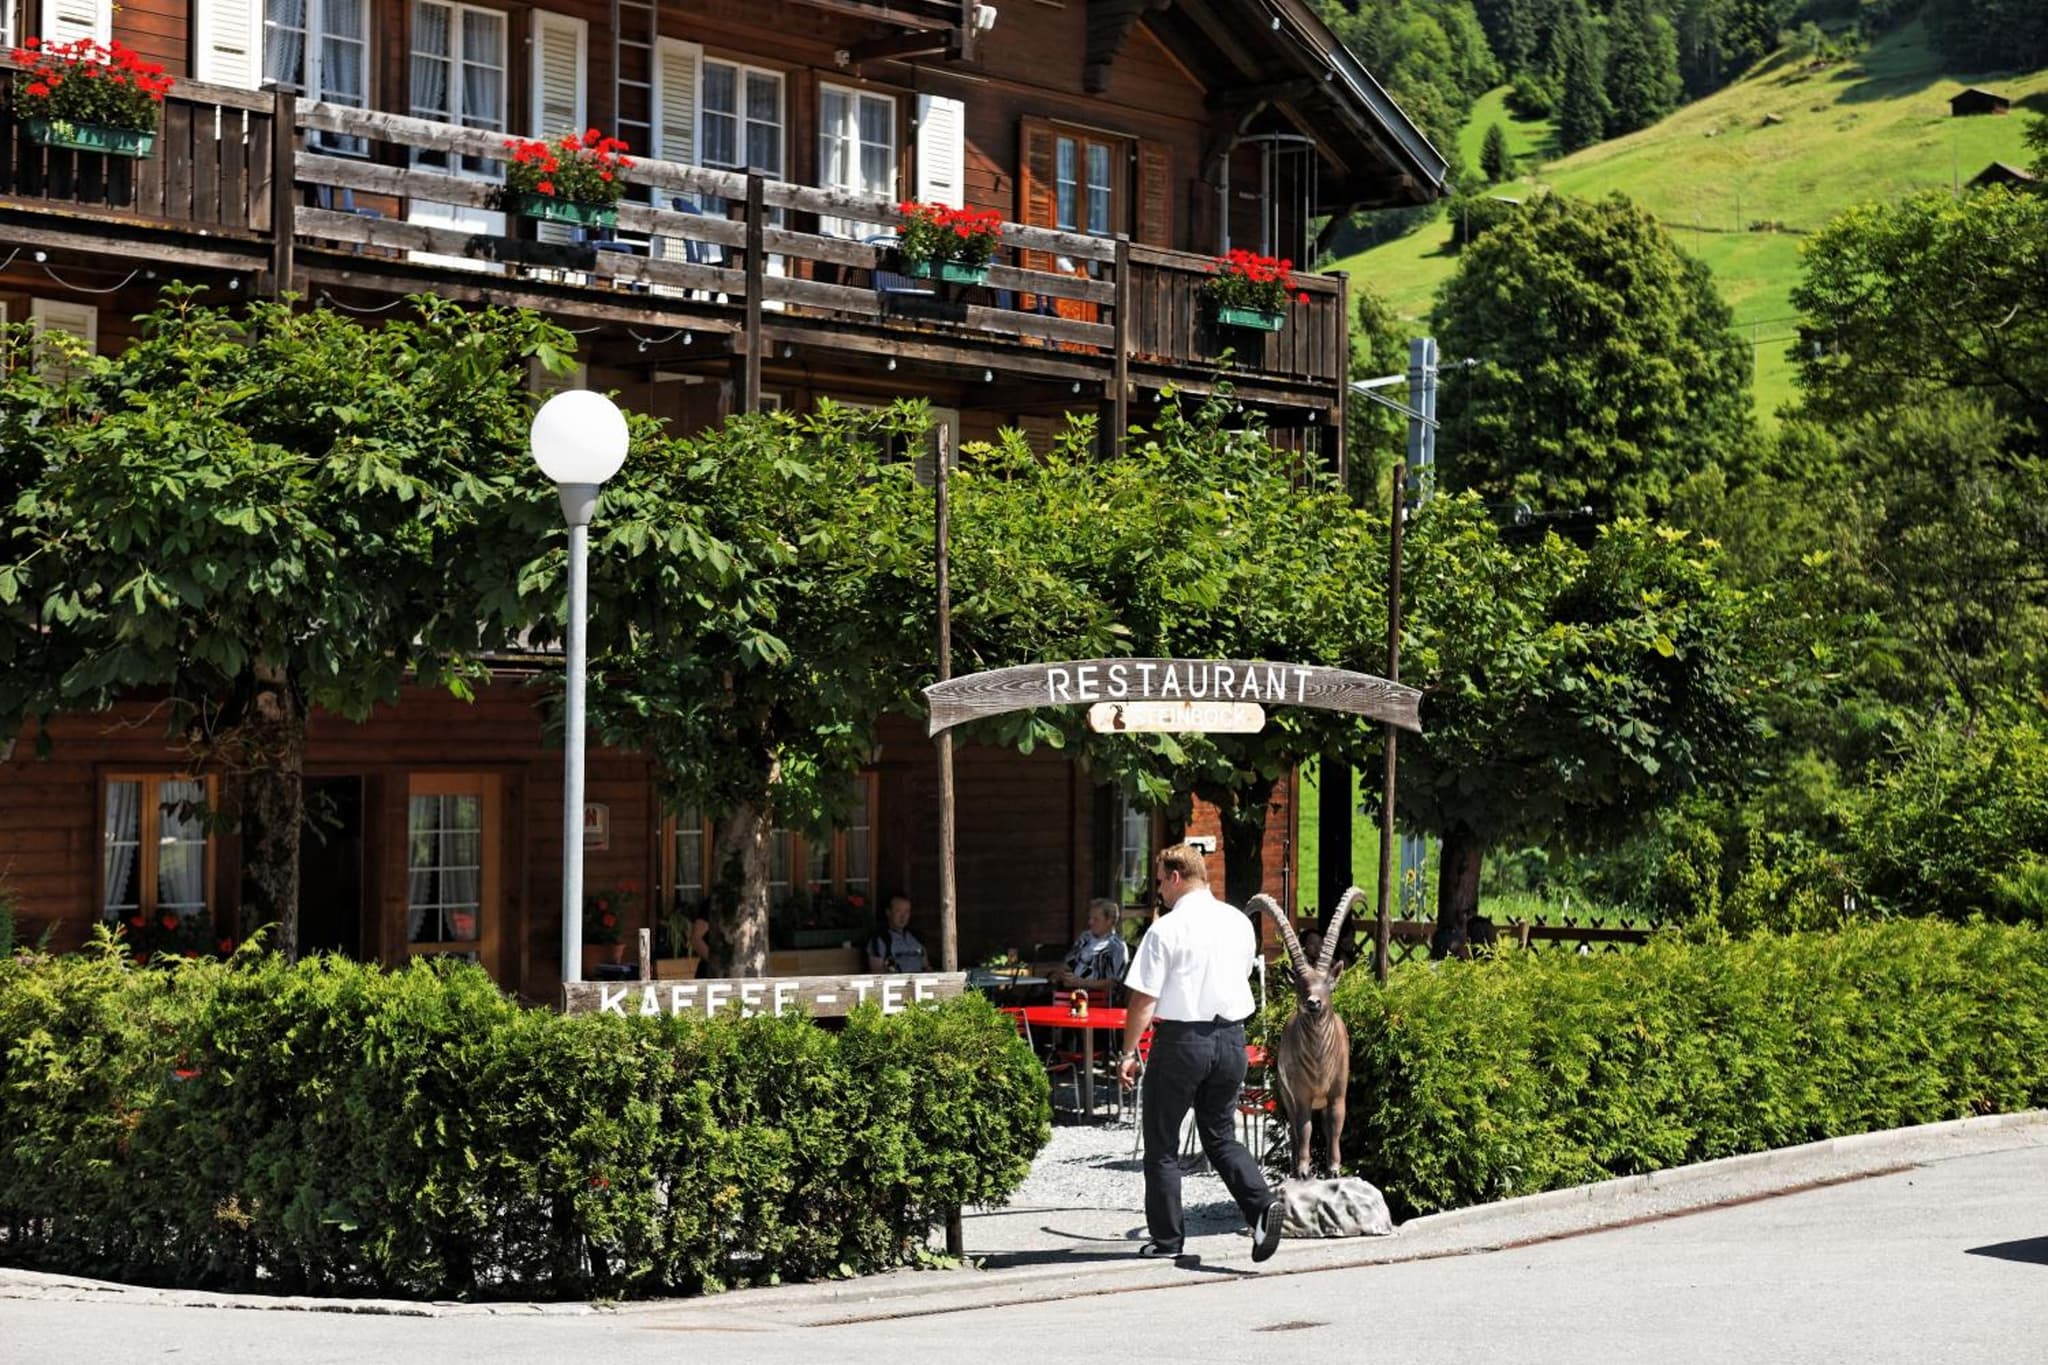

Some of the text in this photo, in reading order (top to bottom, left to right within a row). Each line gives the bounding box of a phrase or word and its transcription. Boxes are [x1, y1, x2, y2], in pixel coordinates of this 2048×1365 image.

[1047, 663, 1313, 703] RESTAURANT
[1133, 706, 1247, 726] STEINBOCK
[600, 982, 799, 1019] KAFFEE
[850, 978, 940, 1015] TEE
